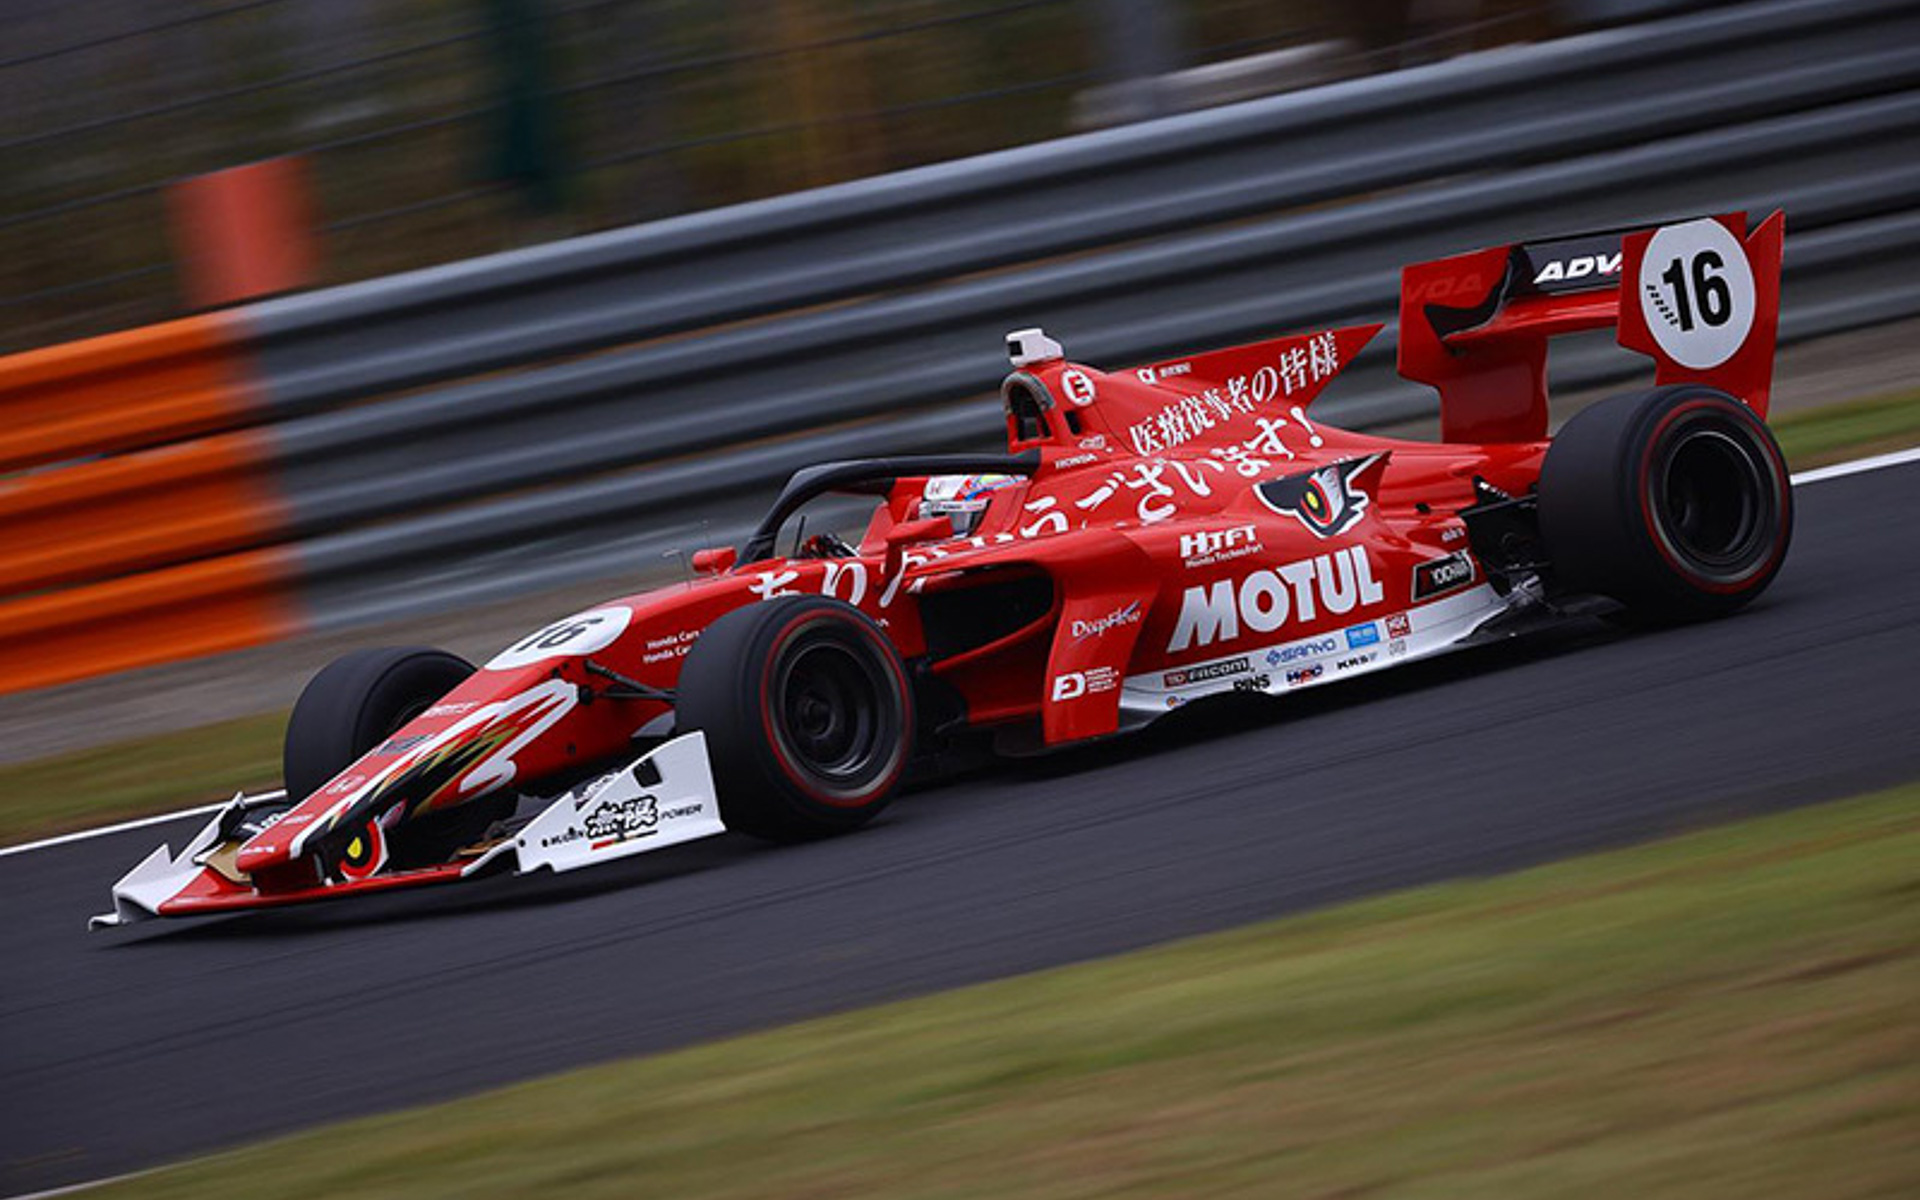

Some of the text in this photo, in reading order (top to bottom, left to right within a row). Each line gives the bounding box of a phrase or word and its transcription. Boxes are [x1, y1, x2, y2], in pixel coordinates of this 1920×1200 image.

[1533, 253, 1622, 284] ADV
[1662, 250, 1732, 332] 16
[1130, 332, 1339, 457] 医療従事者の皆様
[1180, 525, 1256, 558] HTFT
[1166, 545, 1383, 653] MOTUL
[515, 618, 603, 652] 16
[660, 804, 703, 821] POWER
